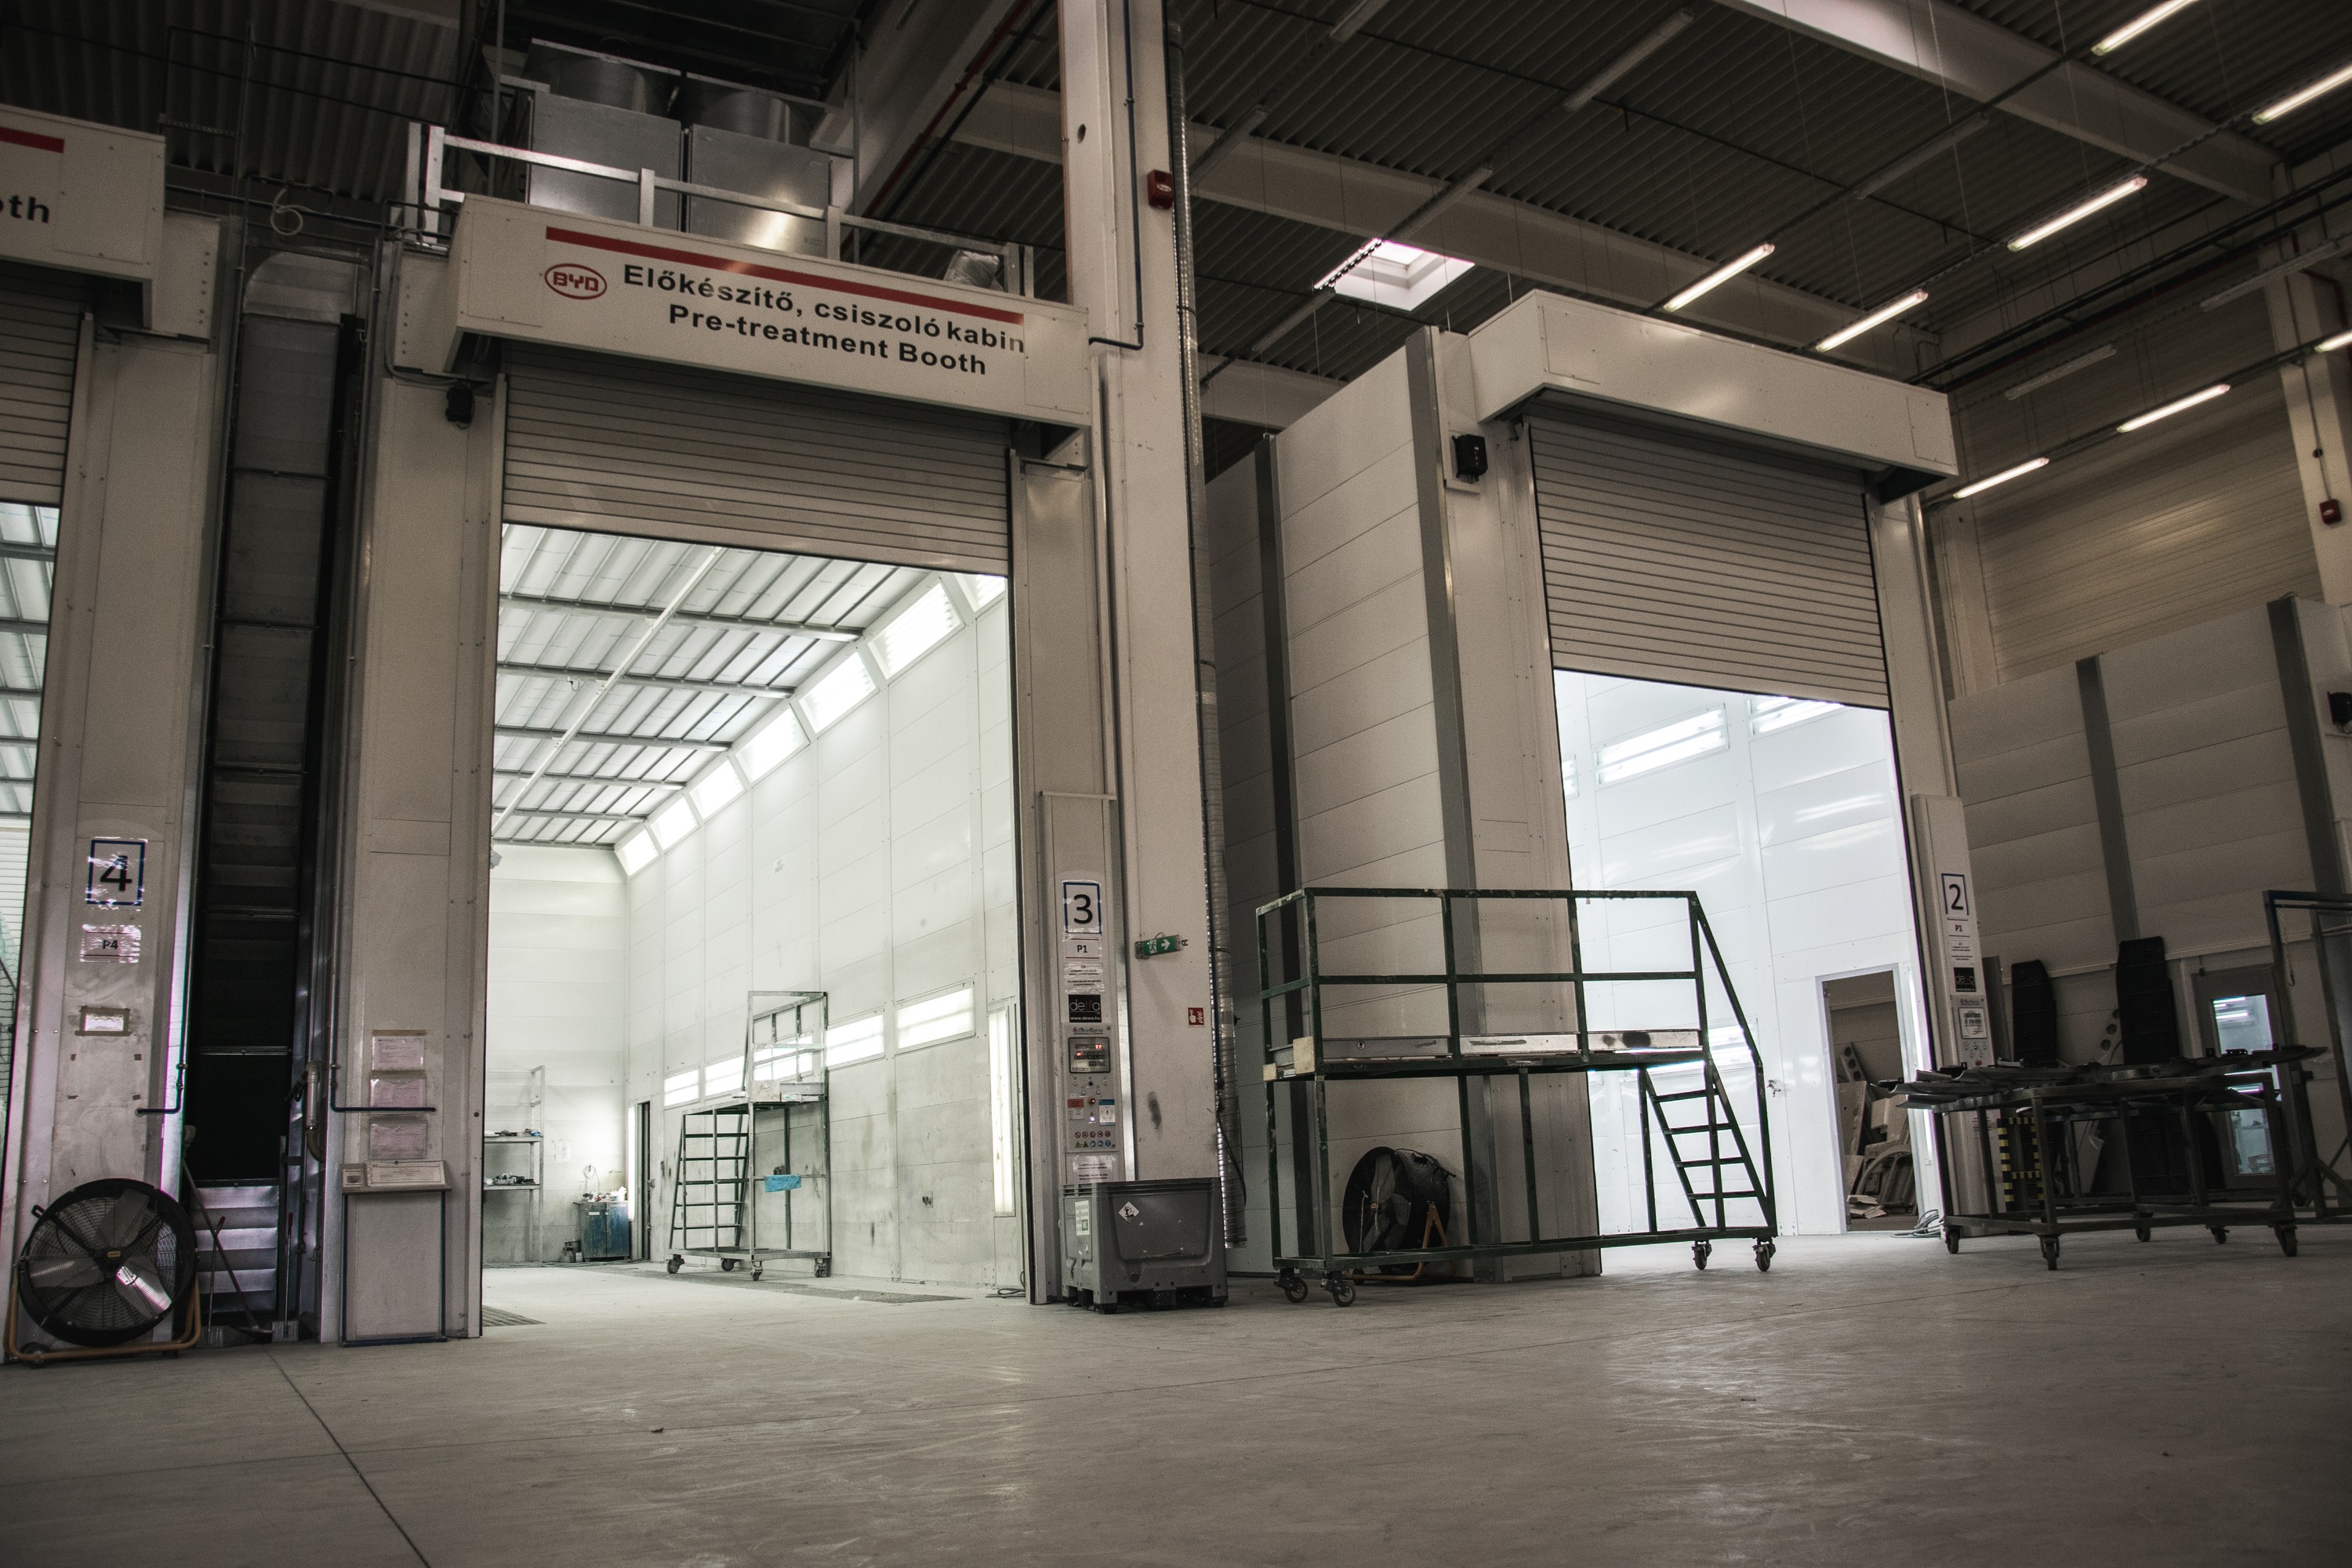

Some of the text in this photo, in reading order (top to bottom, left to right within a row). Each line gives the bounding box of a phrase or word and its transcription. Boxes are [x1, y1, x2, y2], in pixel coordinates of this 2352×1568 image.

[0, 195, 49, 223] th
[553, 271, 599, 292] BYD
[623, 264, 1024, 354] Előkészítő, csiszoló kabin
[669, 304, 985, 376] Pre-treatment Booth
[100, 855, 132, 891] 4
[1073, 894, 1093, 924] 3
[1948, 884, 1964, 911] 2
[102, 939, 119, 950] P4
[1076, 945, 1088, 953] P1
